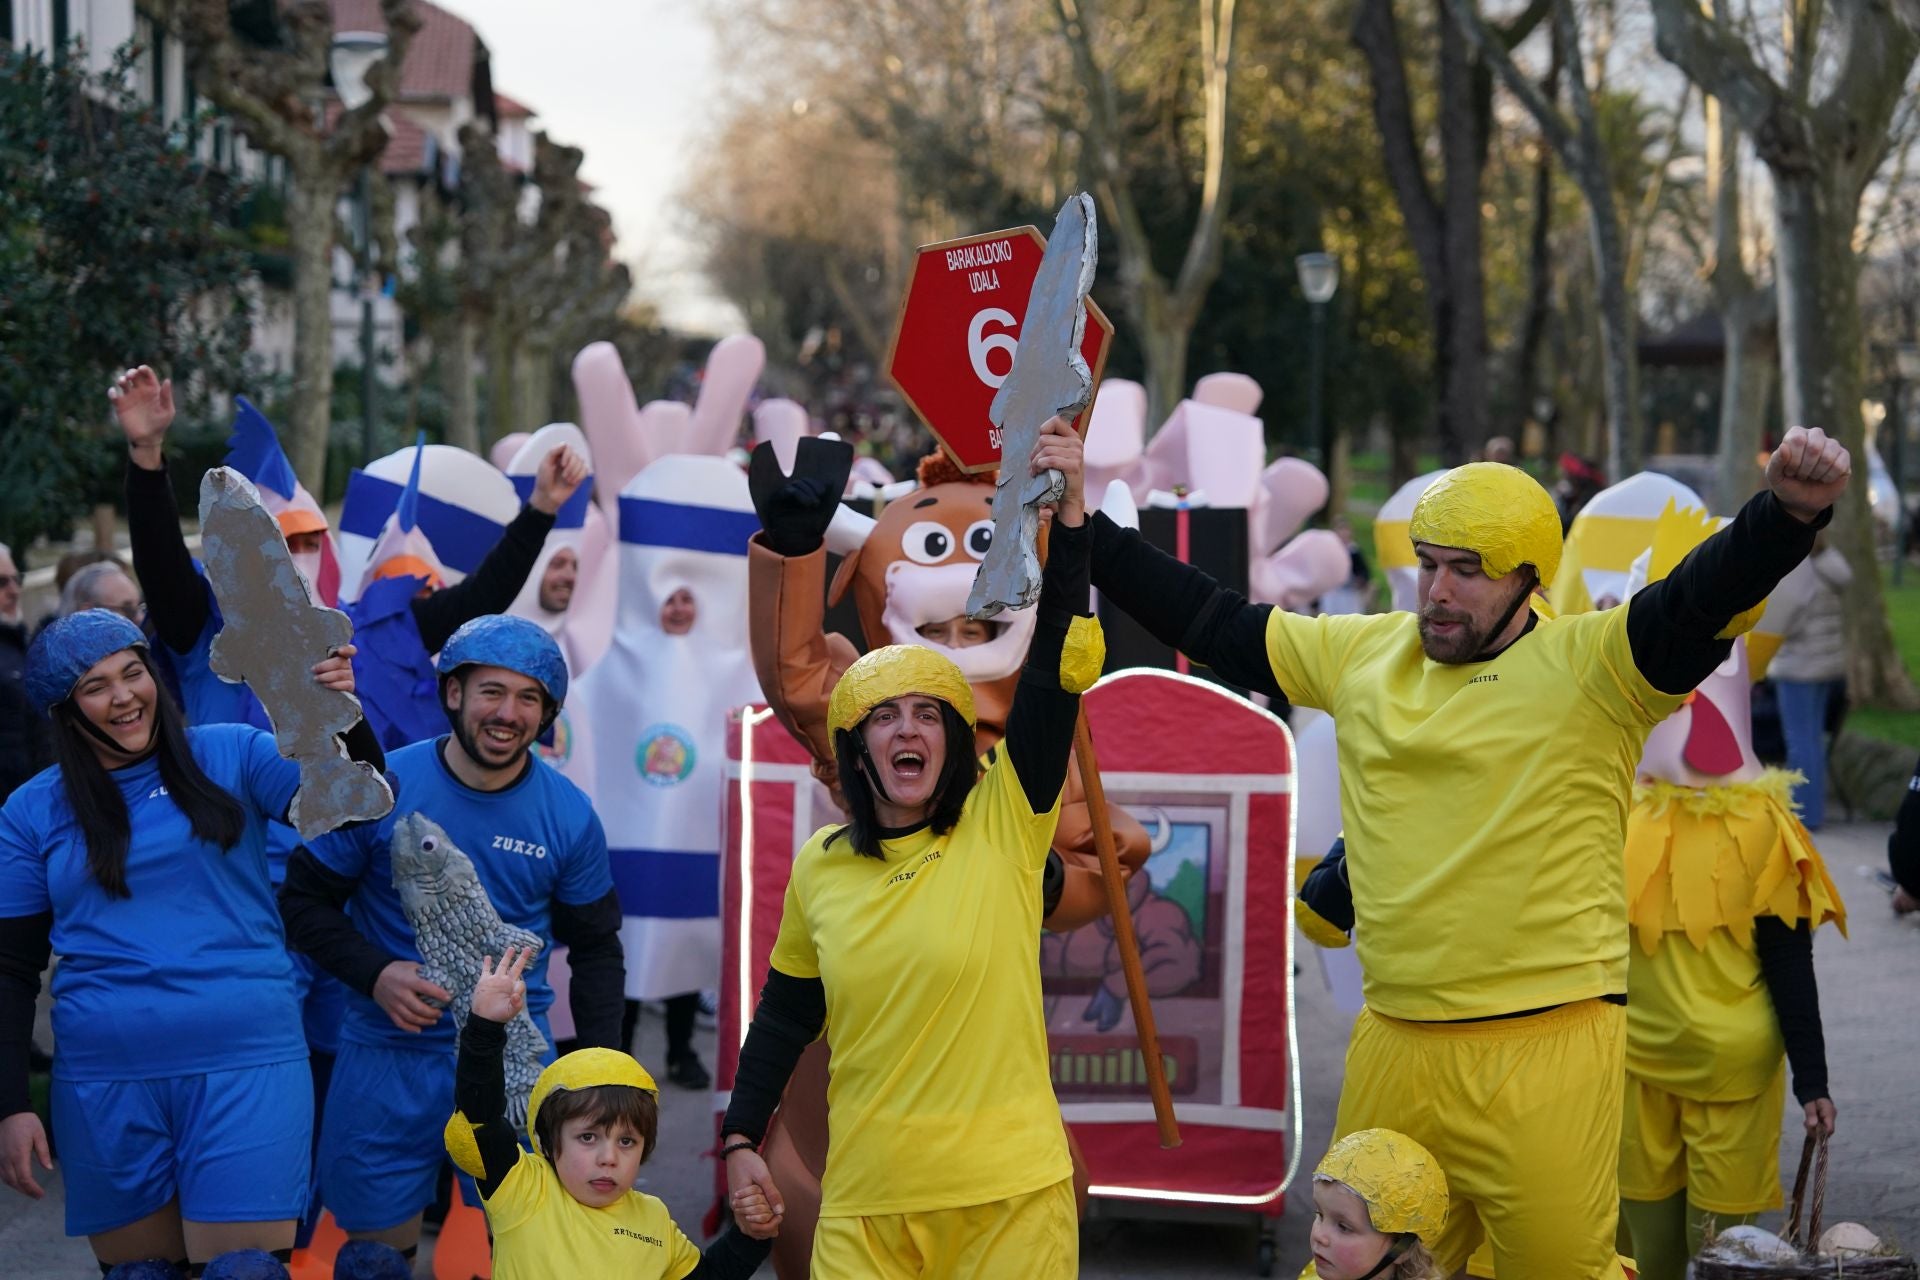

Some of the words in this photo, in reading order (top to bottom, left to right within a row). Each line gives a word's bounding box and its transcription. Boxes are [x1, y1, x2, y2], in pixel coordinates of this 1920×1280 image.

[946, 240, 1012, 271] BARAKALDOKO
[968, 268, 1000, 293] UDALA
[967, 307, 1019, 390] 6
[492, 835, 546, 859] ZUAZO
